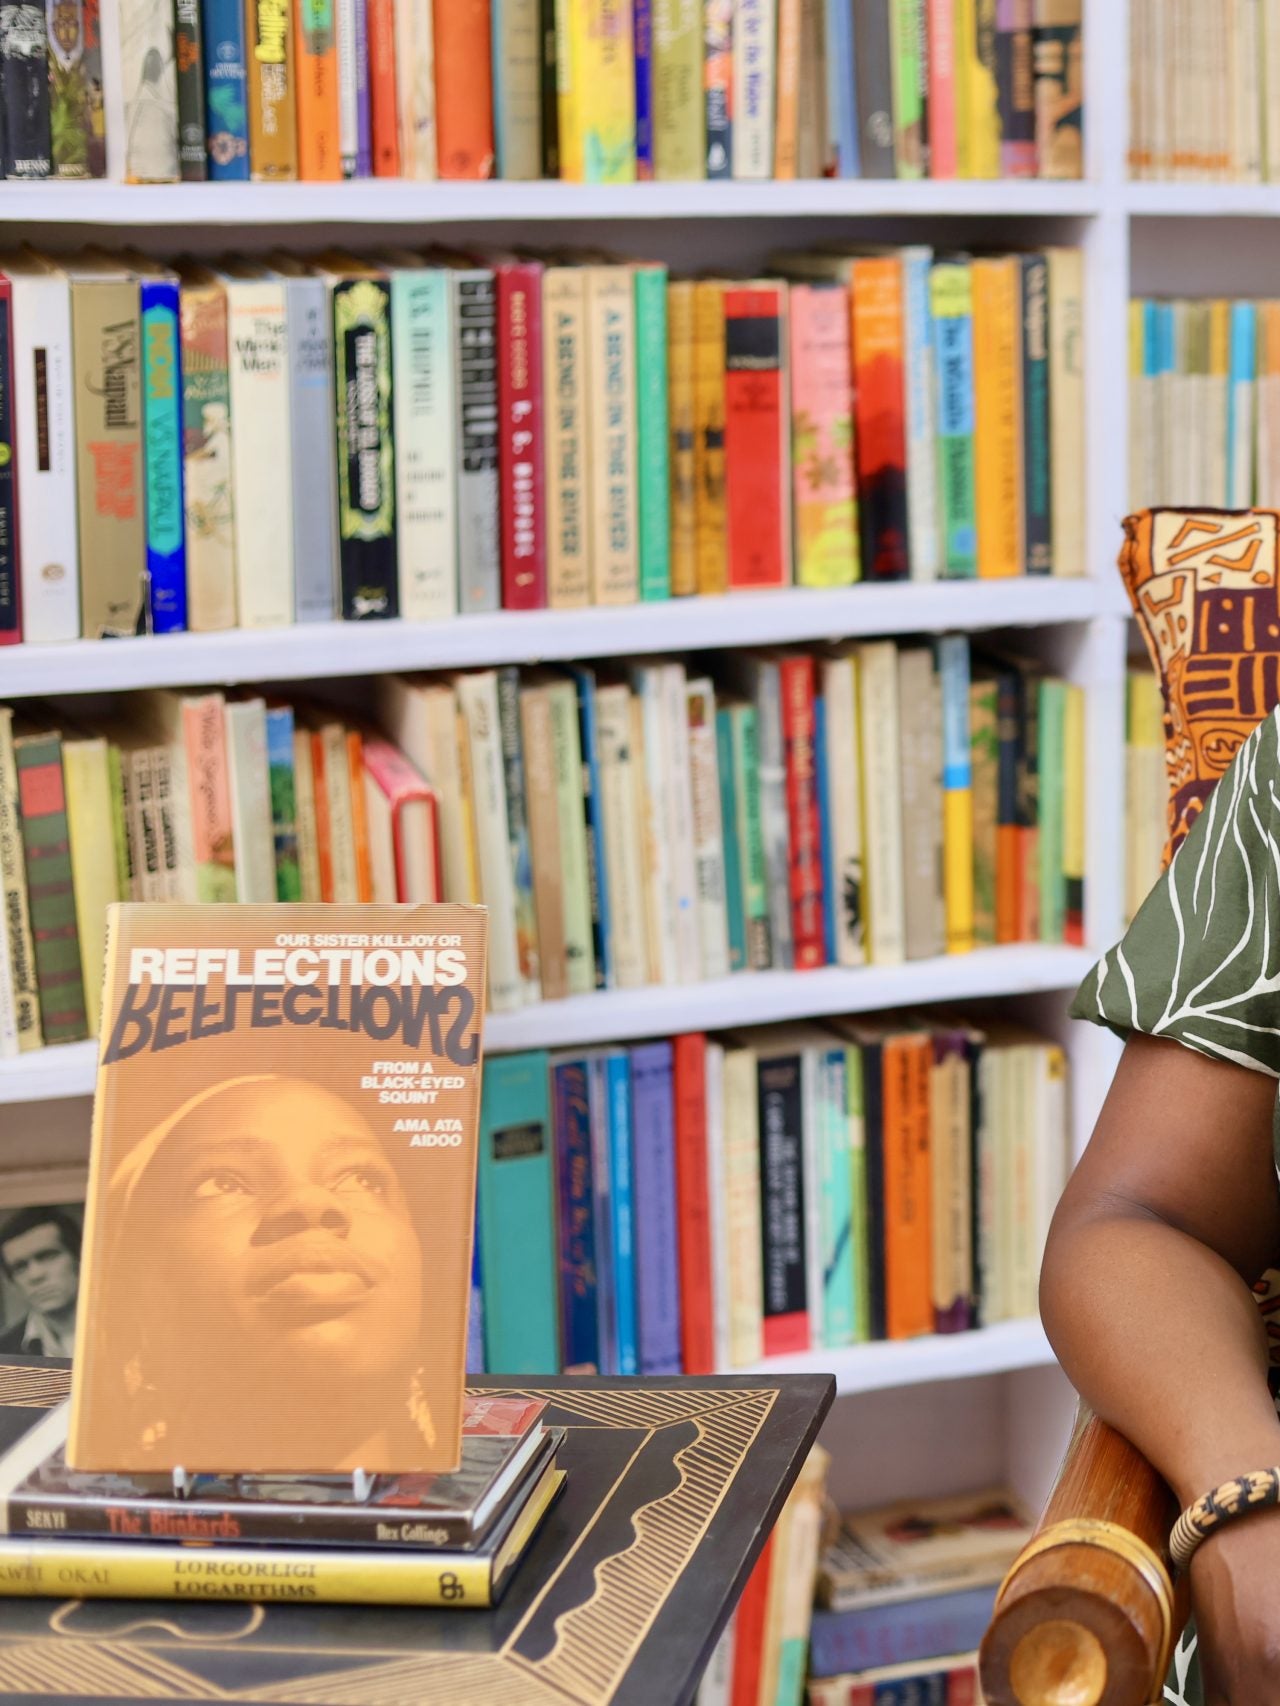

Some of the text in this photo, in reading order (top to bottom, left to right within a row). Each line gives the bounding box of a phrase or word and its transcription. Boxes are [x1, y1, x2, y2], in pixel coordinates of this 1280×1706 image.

[461, 281, 498, 472] GUERRILLAS
[276, 934, 462, 947] OUR SISTER KILLJOY OR
[129, 948, 468, 987] REFLECTIONS
[372, 1061, 434, 1075] FROM A
[360, 1076, 465, 1089] BLACK-EYED
[378, 1090, 439, 1104] SQUINT
[393, 1118, 463, 1132] AMA ATA
[409, 1133, 463, 1147] AIDOO
[26, 1508, 67, 1529] SEKYI
[105, 1507, 241, 1538] The Blinkards
[376, 1523, 449, 1546] Rex Collings
[58, 1567, 110, 1585] OKAI
[174, 1559, 317, 1579] LORGORLIGI
[174, 1581, 317, 1598] LOGARITHMS
